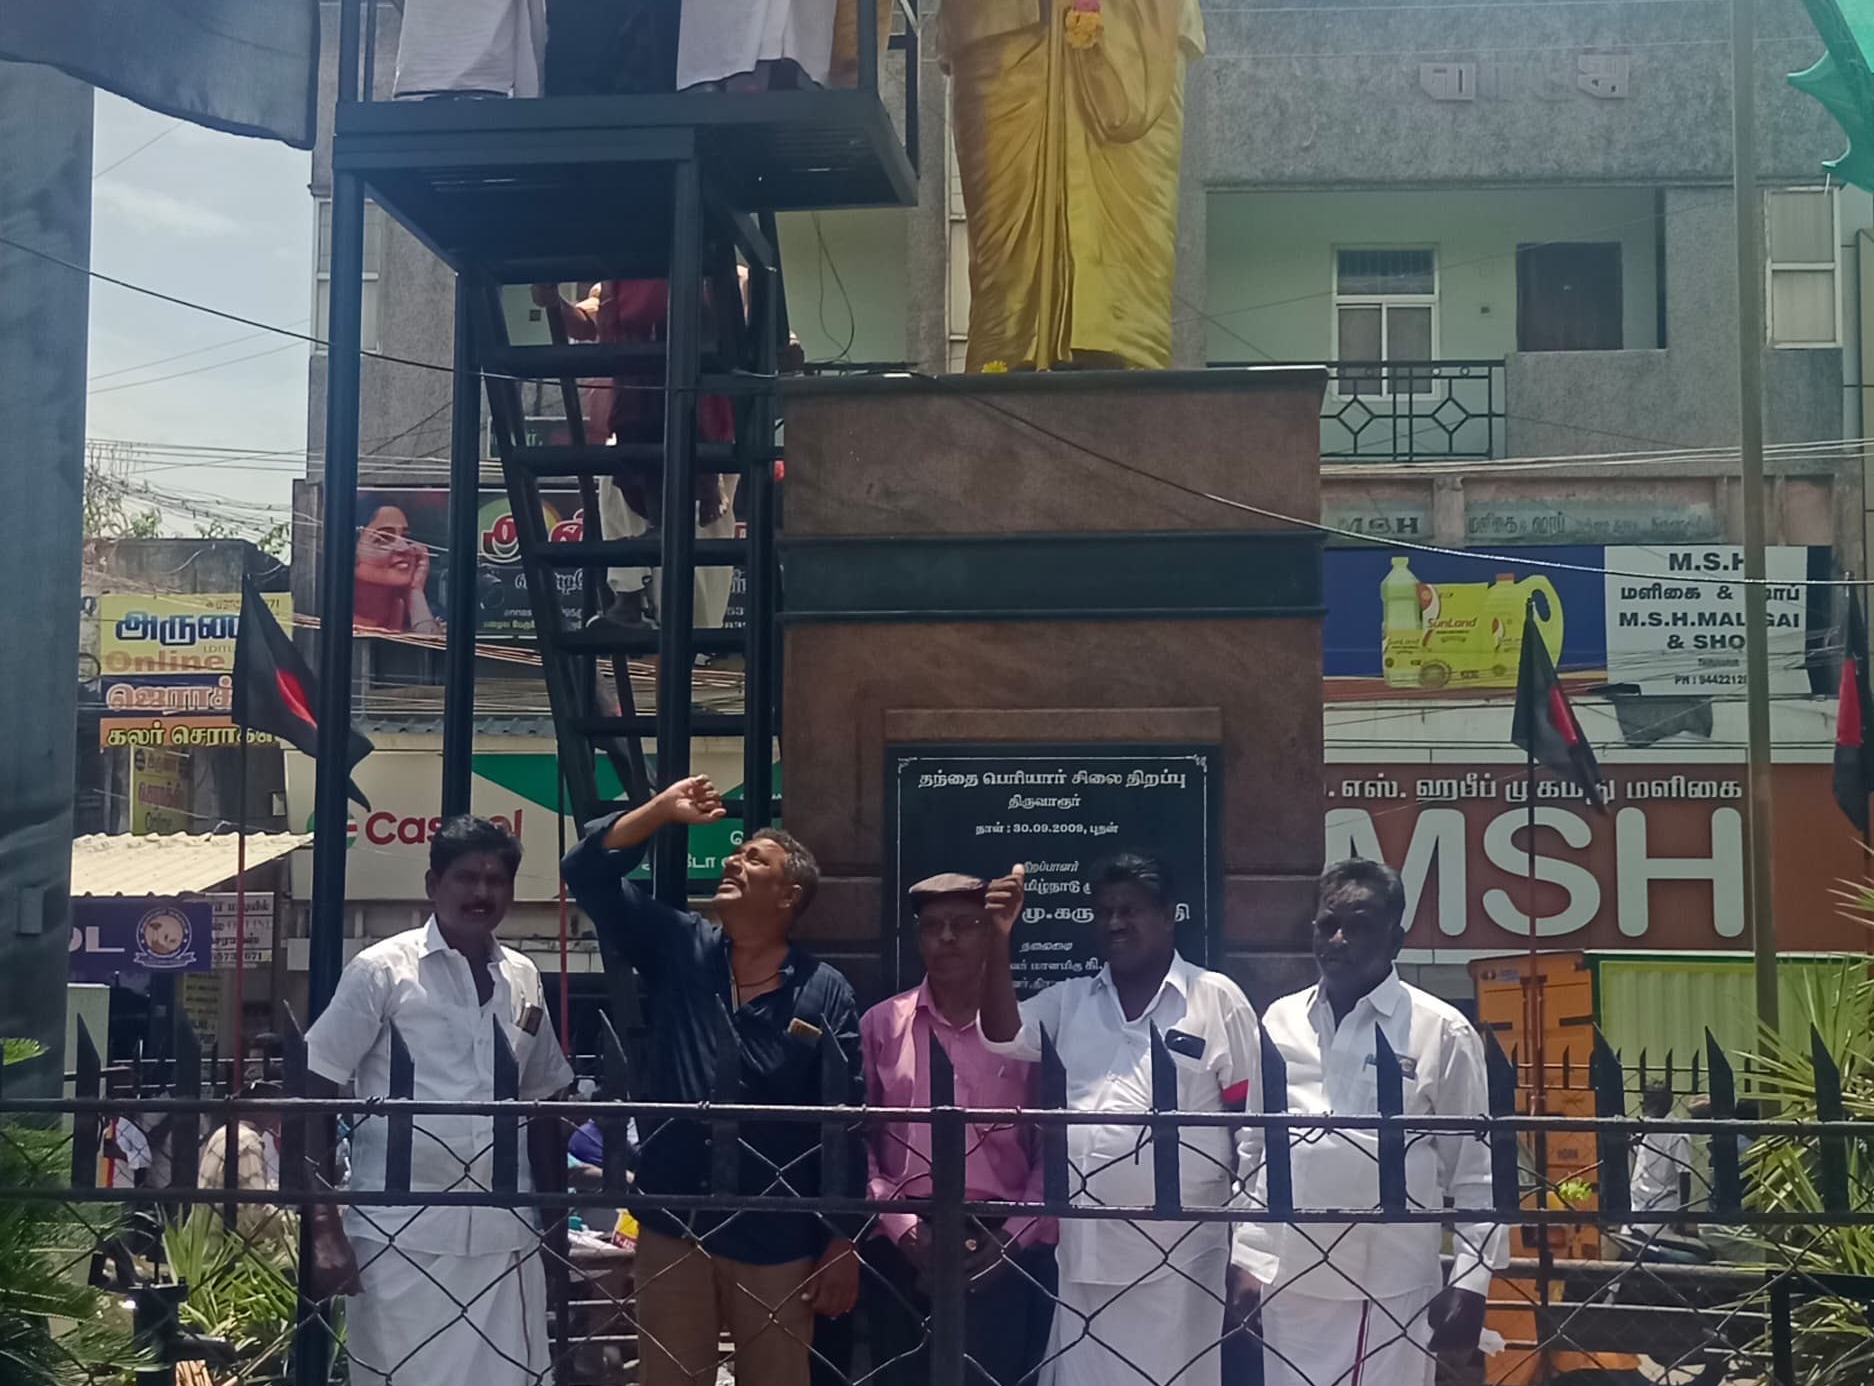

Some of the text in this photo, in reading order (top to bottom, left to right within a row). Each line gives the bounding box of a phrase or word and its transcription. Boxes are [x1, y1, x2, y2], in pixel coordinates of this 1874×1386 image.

[1621, 582, 1700, 600] மளிகை
[1716, 585, 1733, 600] &
[1619, 612, 1800, 628] M.S.H.MALGAI
[1666, 634, 1746, 649] & SHO
[105, 650, 226, 673] Online
[107, 720, 165, 746] கலர்
[918, 768, 1186, 789] தந்தை பெரியார் சிலை திறப்பு
[1416, 772, 1497, 801] ஹபீப்
[1626, 775, 1743, 800] மளிகை
[364, 809, 523, 846] Casl
[1013, 824, 1088, 835] 30.09.2009,
[1325, 805, 1745, 938] MSH
[1023, 878, 1080, 894] மிழ்நாடு
